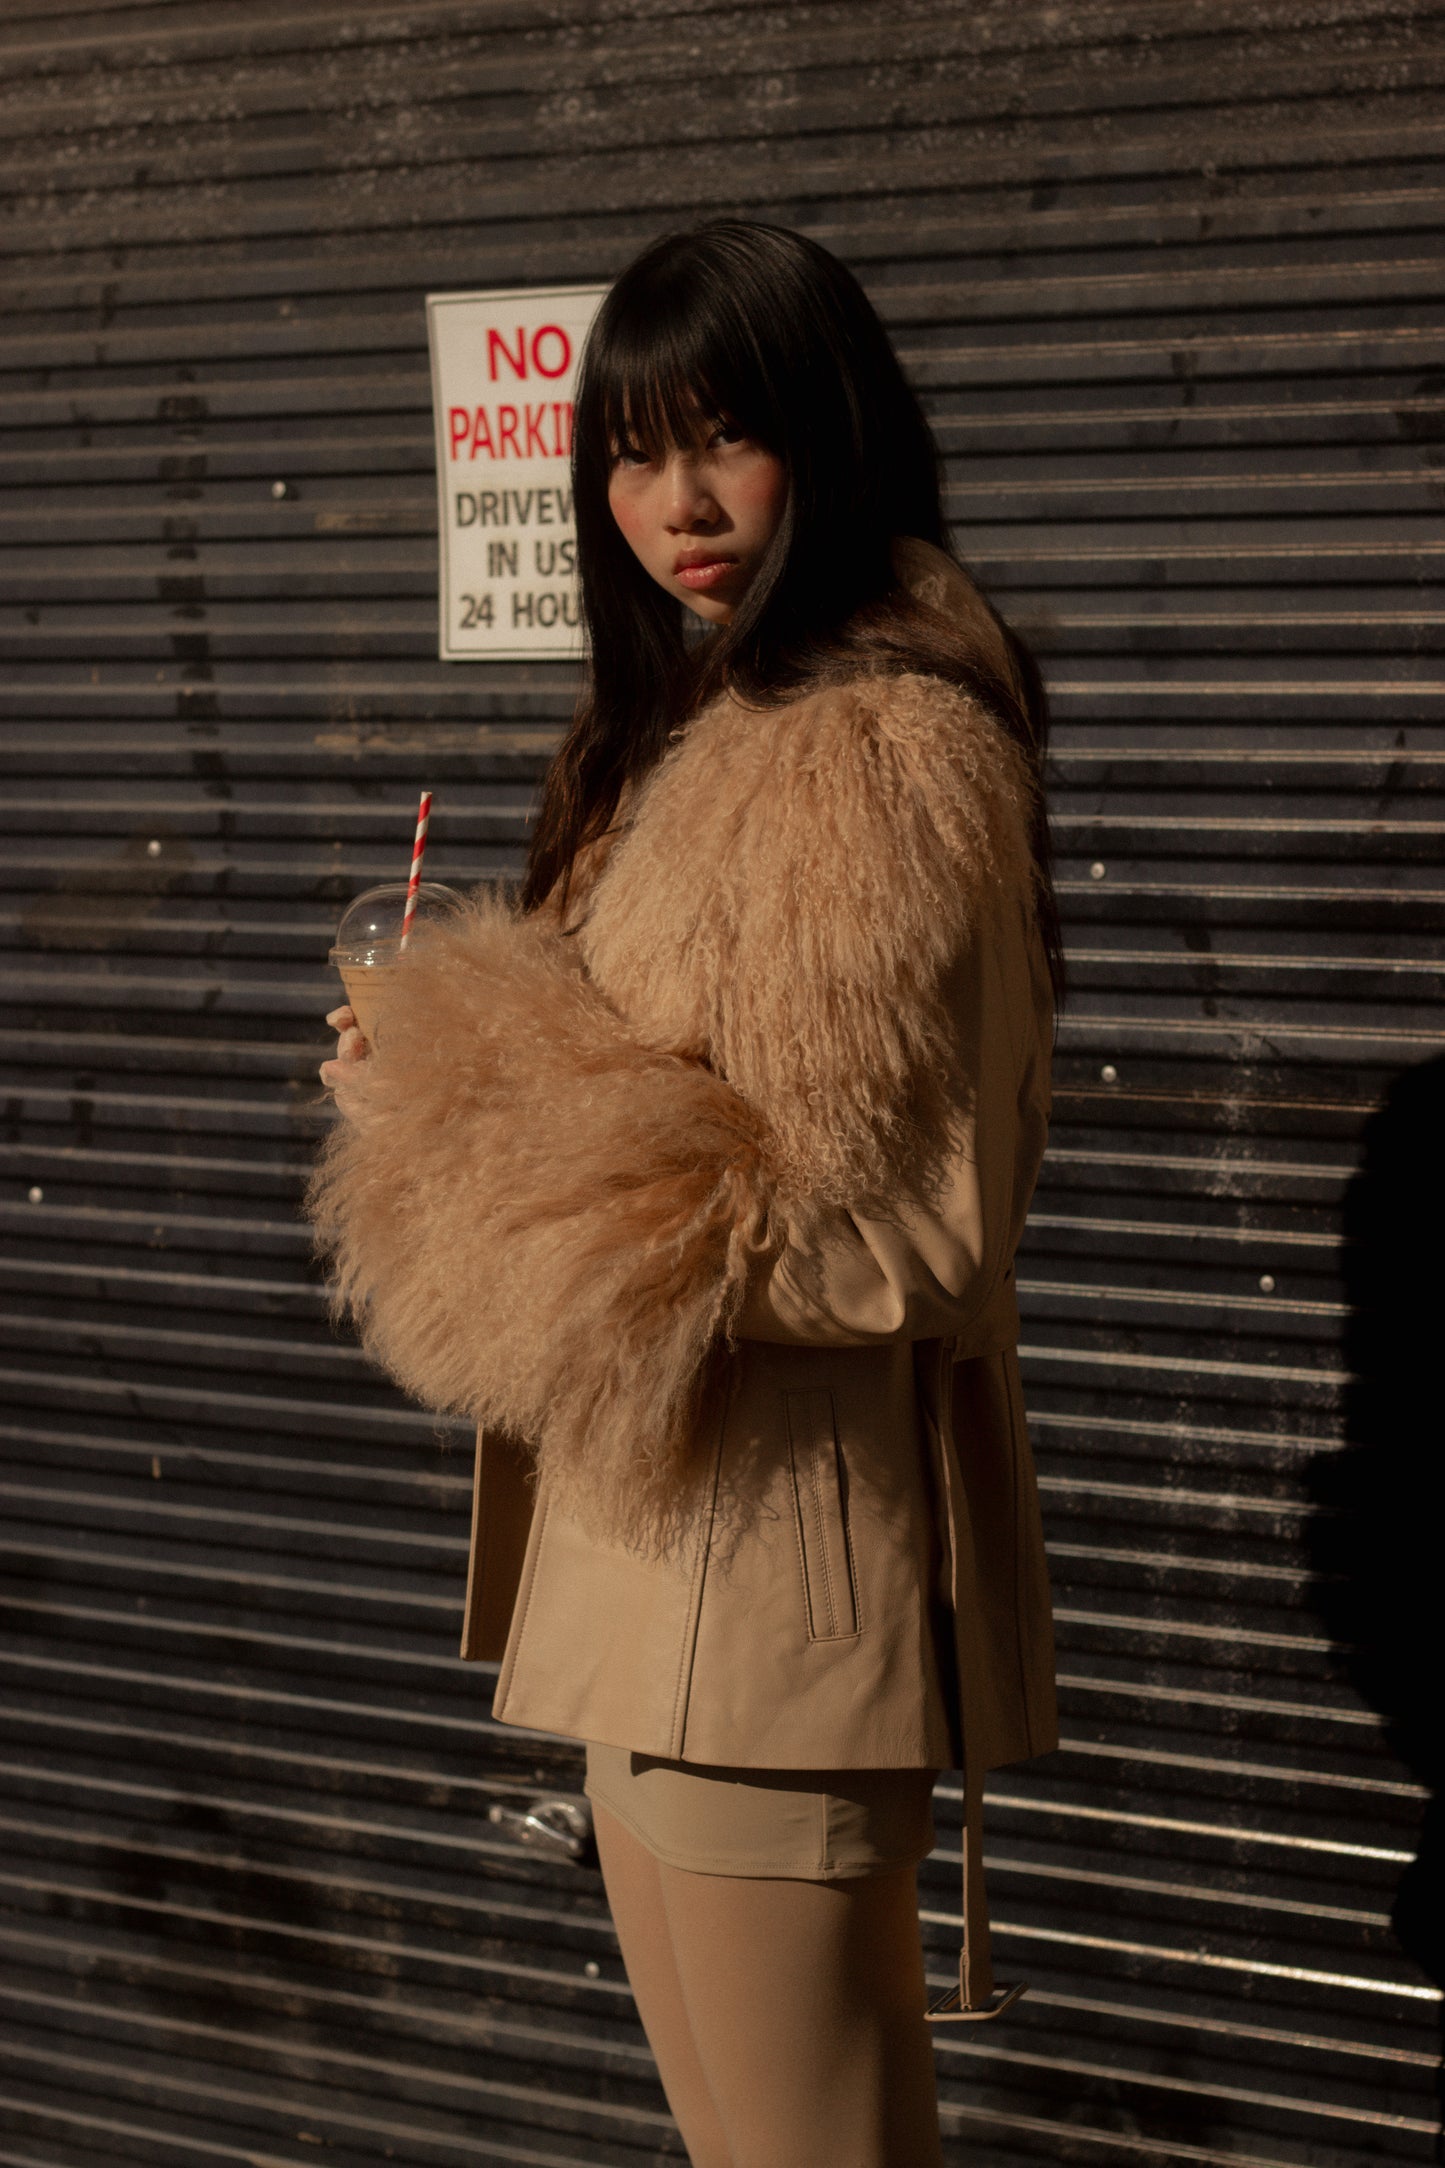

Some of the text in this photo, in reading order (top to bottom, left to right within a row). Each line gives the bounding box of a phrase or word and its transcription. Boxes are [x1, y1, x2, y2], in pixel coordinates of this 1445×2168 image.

[488, 325, 571, 382] NO
[488, 541, 518, 578] IN
[459, 592, 581, 629] 24 HOU
